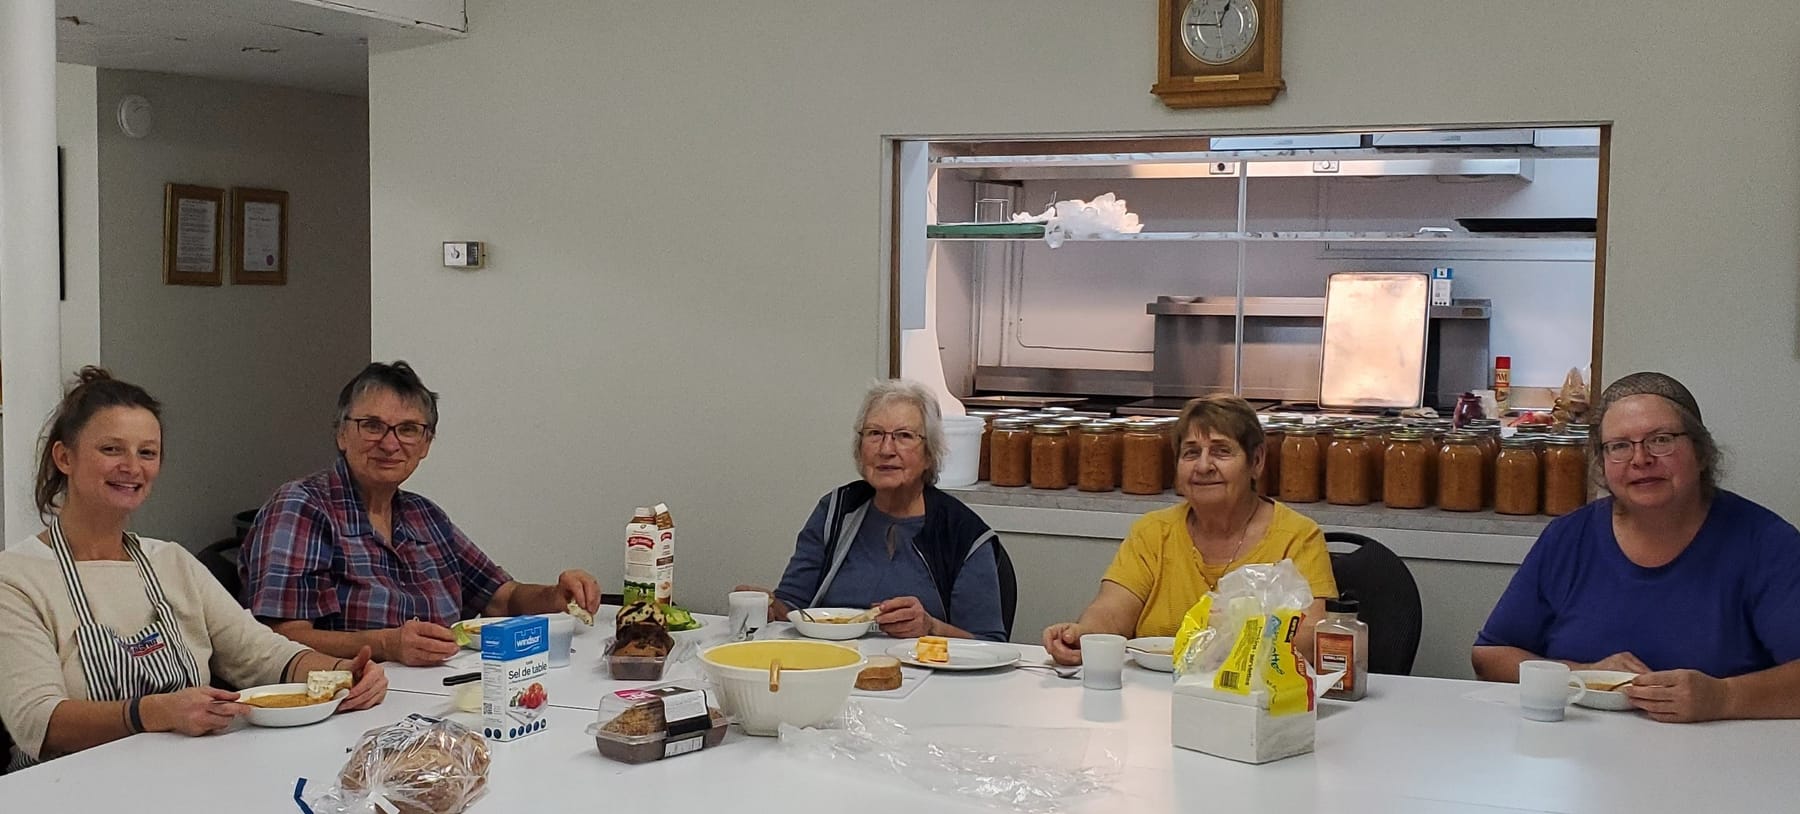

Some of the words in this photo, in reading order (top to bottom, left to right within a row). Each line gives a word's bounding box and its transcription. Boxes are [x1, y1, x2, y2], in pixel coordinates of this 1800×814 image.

[516, 635, 540, 647] windsor
[508, 668, 520, 680] Sel
[521, 666, 531, 677] de
[532, 661, 547, 673] table
